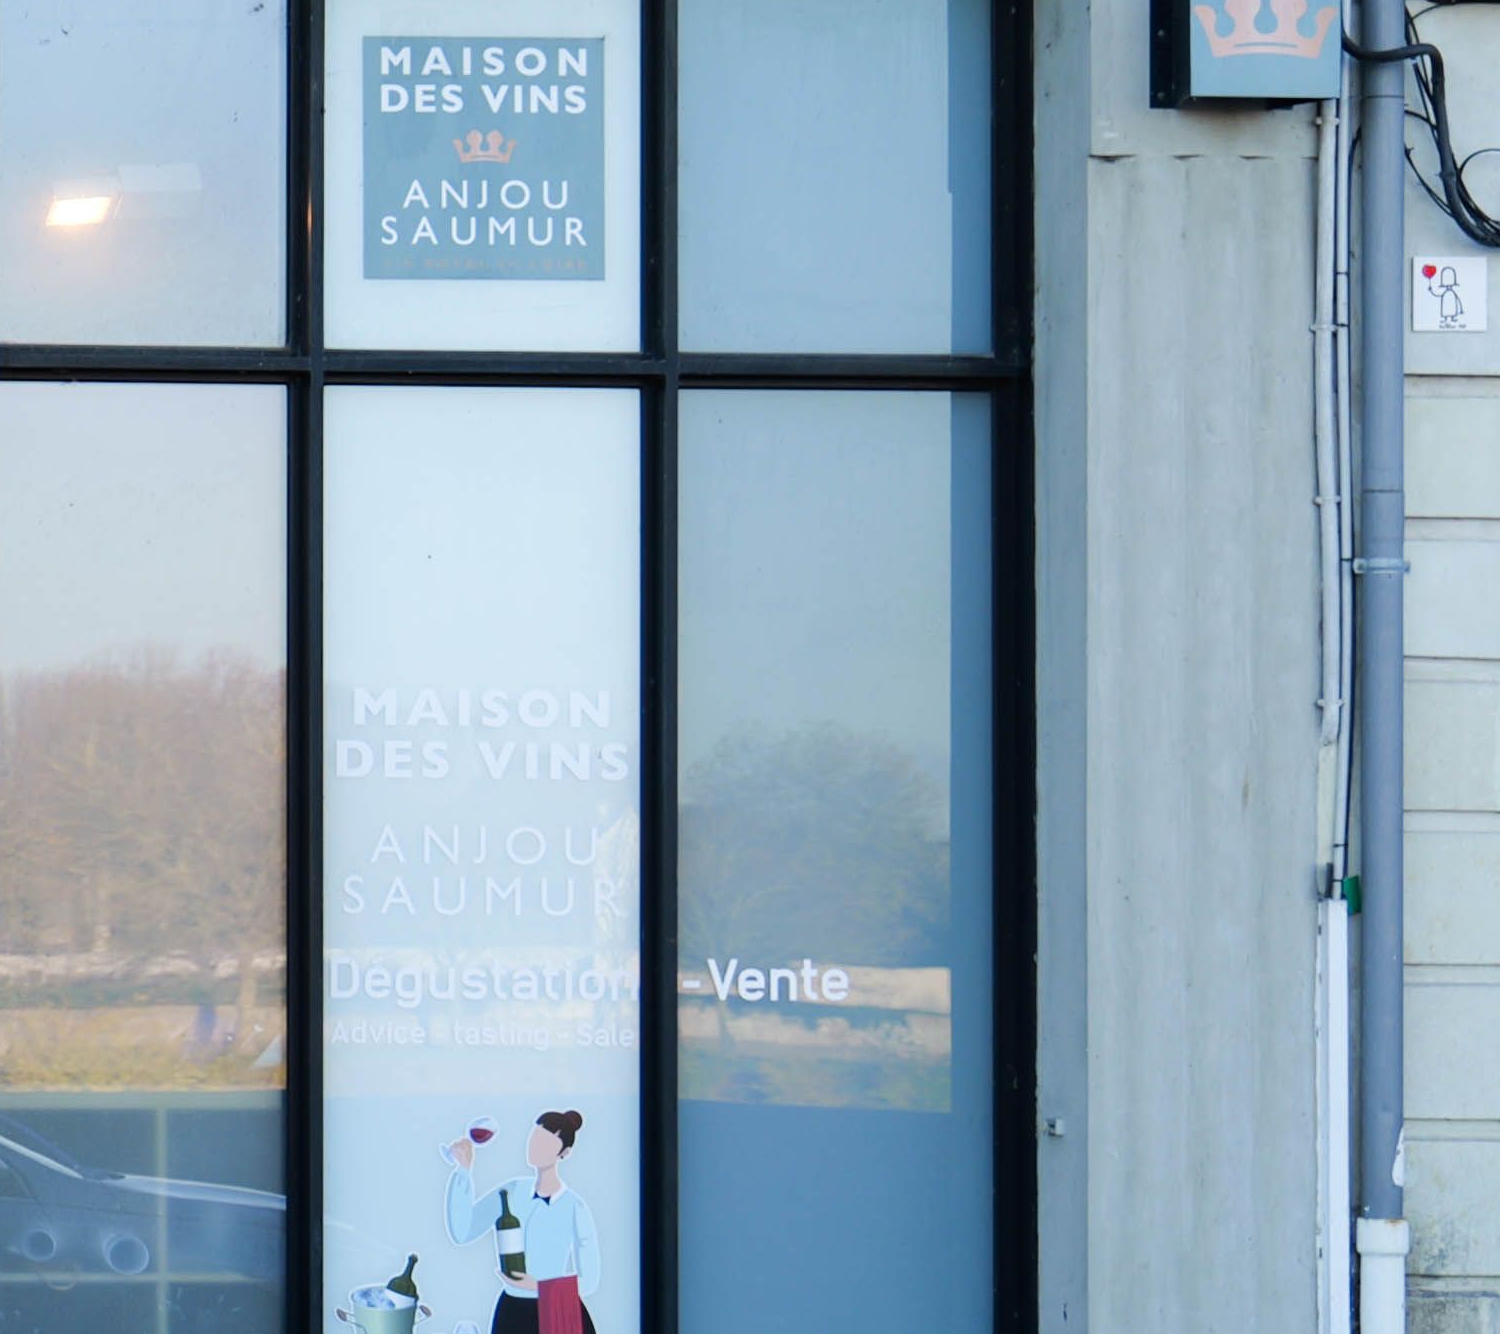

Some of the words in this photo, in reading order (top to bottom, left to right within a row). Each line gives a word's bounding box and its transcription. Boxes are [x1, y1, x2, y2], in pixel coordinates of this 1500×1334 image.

[380, 46, 587, 77] MAISON
[380, 84, 463, 113] DES
[481, 84, 587, 114] VINS
[402, 179, 569, 210] ANJOU
[380, 216, 587, 246] SAUMUR
[352, 687, 611, 729] MAISON
[336, 738, 450, 779] DES
[476, 740, 629, 782] VINS
[370, 822, 598, 866] ANJOU
[342, 874, 620, 916] SAUMUR
[330, 1019, 428, 1045] Advice
[453, 1019, 549, 1051] tasting
[576, 1021, 634, 1048] Sale
